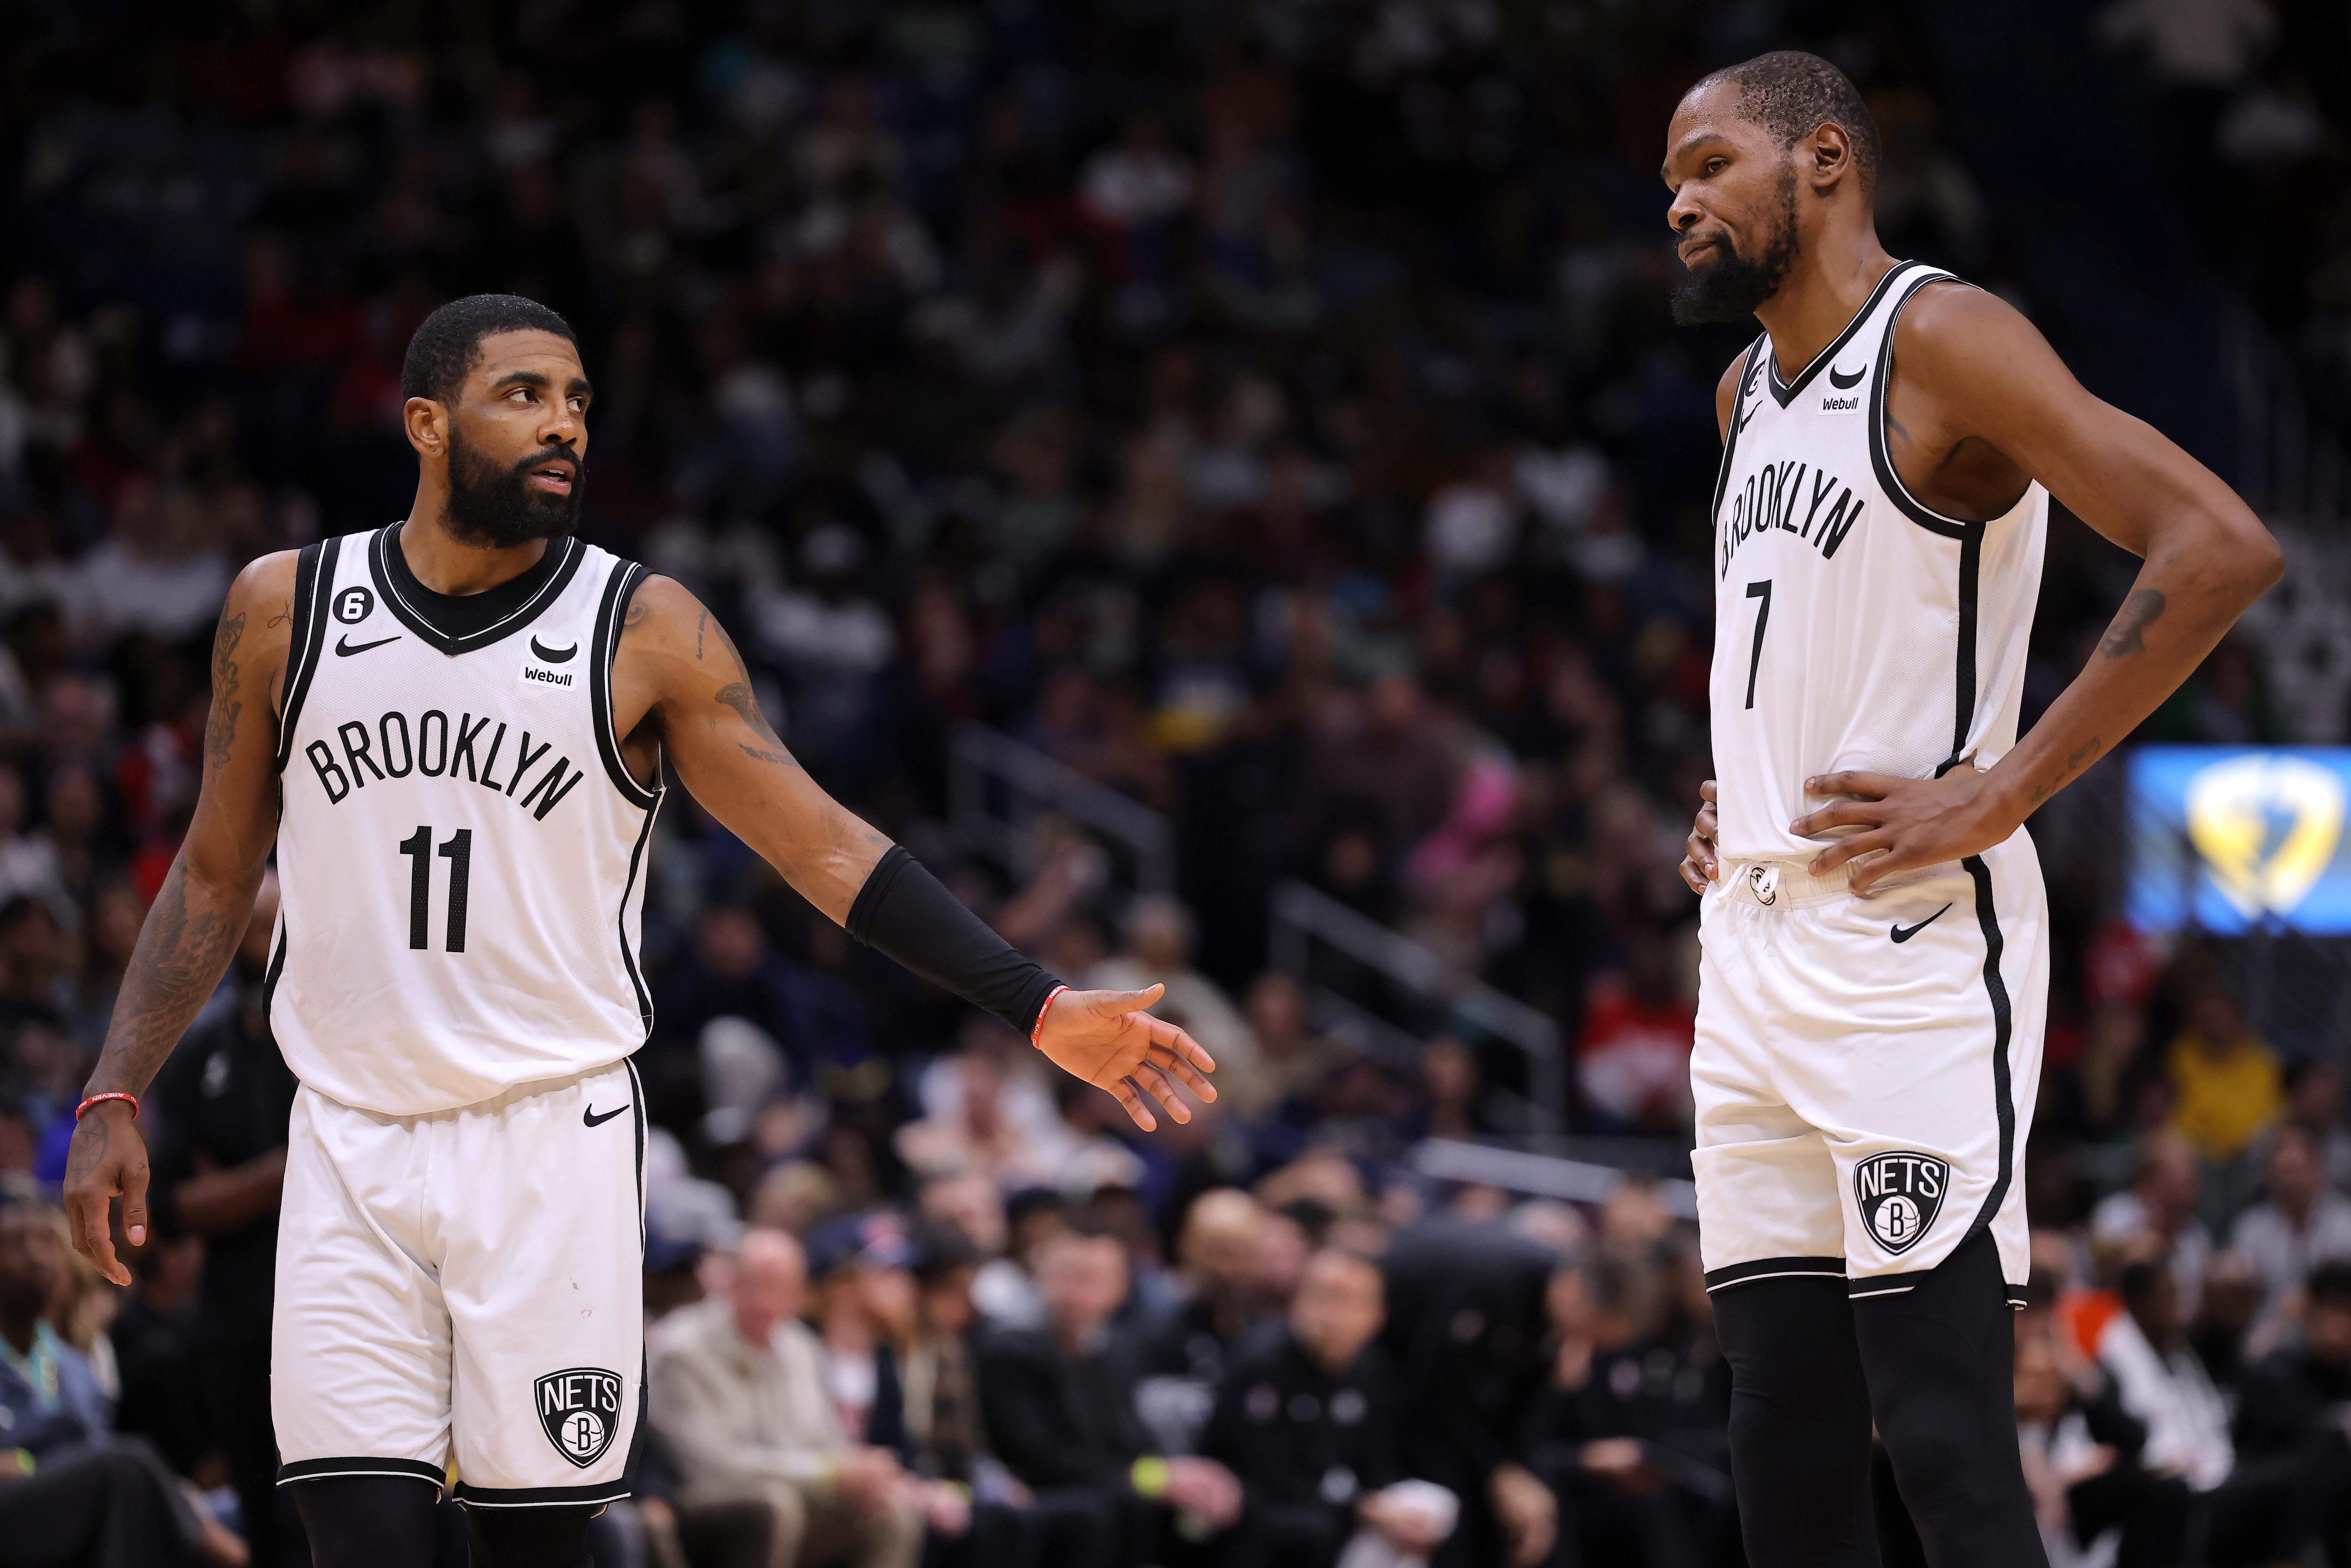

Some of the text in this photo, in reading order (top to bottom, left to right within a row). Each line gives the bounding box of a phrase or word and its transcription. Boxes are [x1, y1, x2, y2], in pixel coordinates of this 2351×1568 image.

[1823, 397, 1858, 410] Webull
[1722, 461, 1864, 582] BROOKLYN
[342, 591, 365, 620] 6
[1745, 579, 1772, 709] 7
[525, 667, 572, 687] Webull
[306, 709, 584, 821] BROOKLYN
[400, 826, 472, 953] 11
[1861, 1158, 1940, 1201] NETS
[1890, 1203, 1904, 1237] B
[544, 1375, 617, 1416] NETS
[577, 1418, 591, 1451] B
